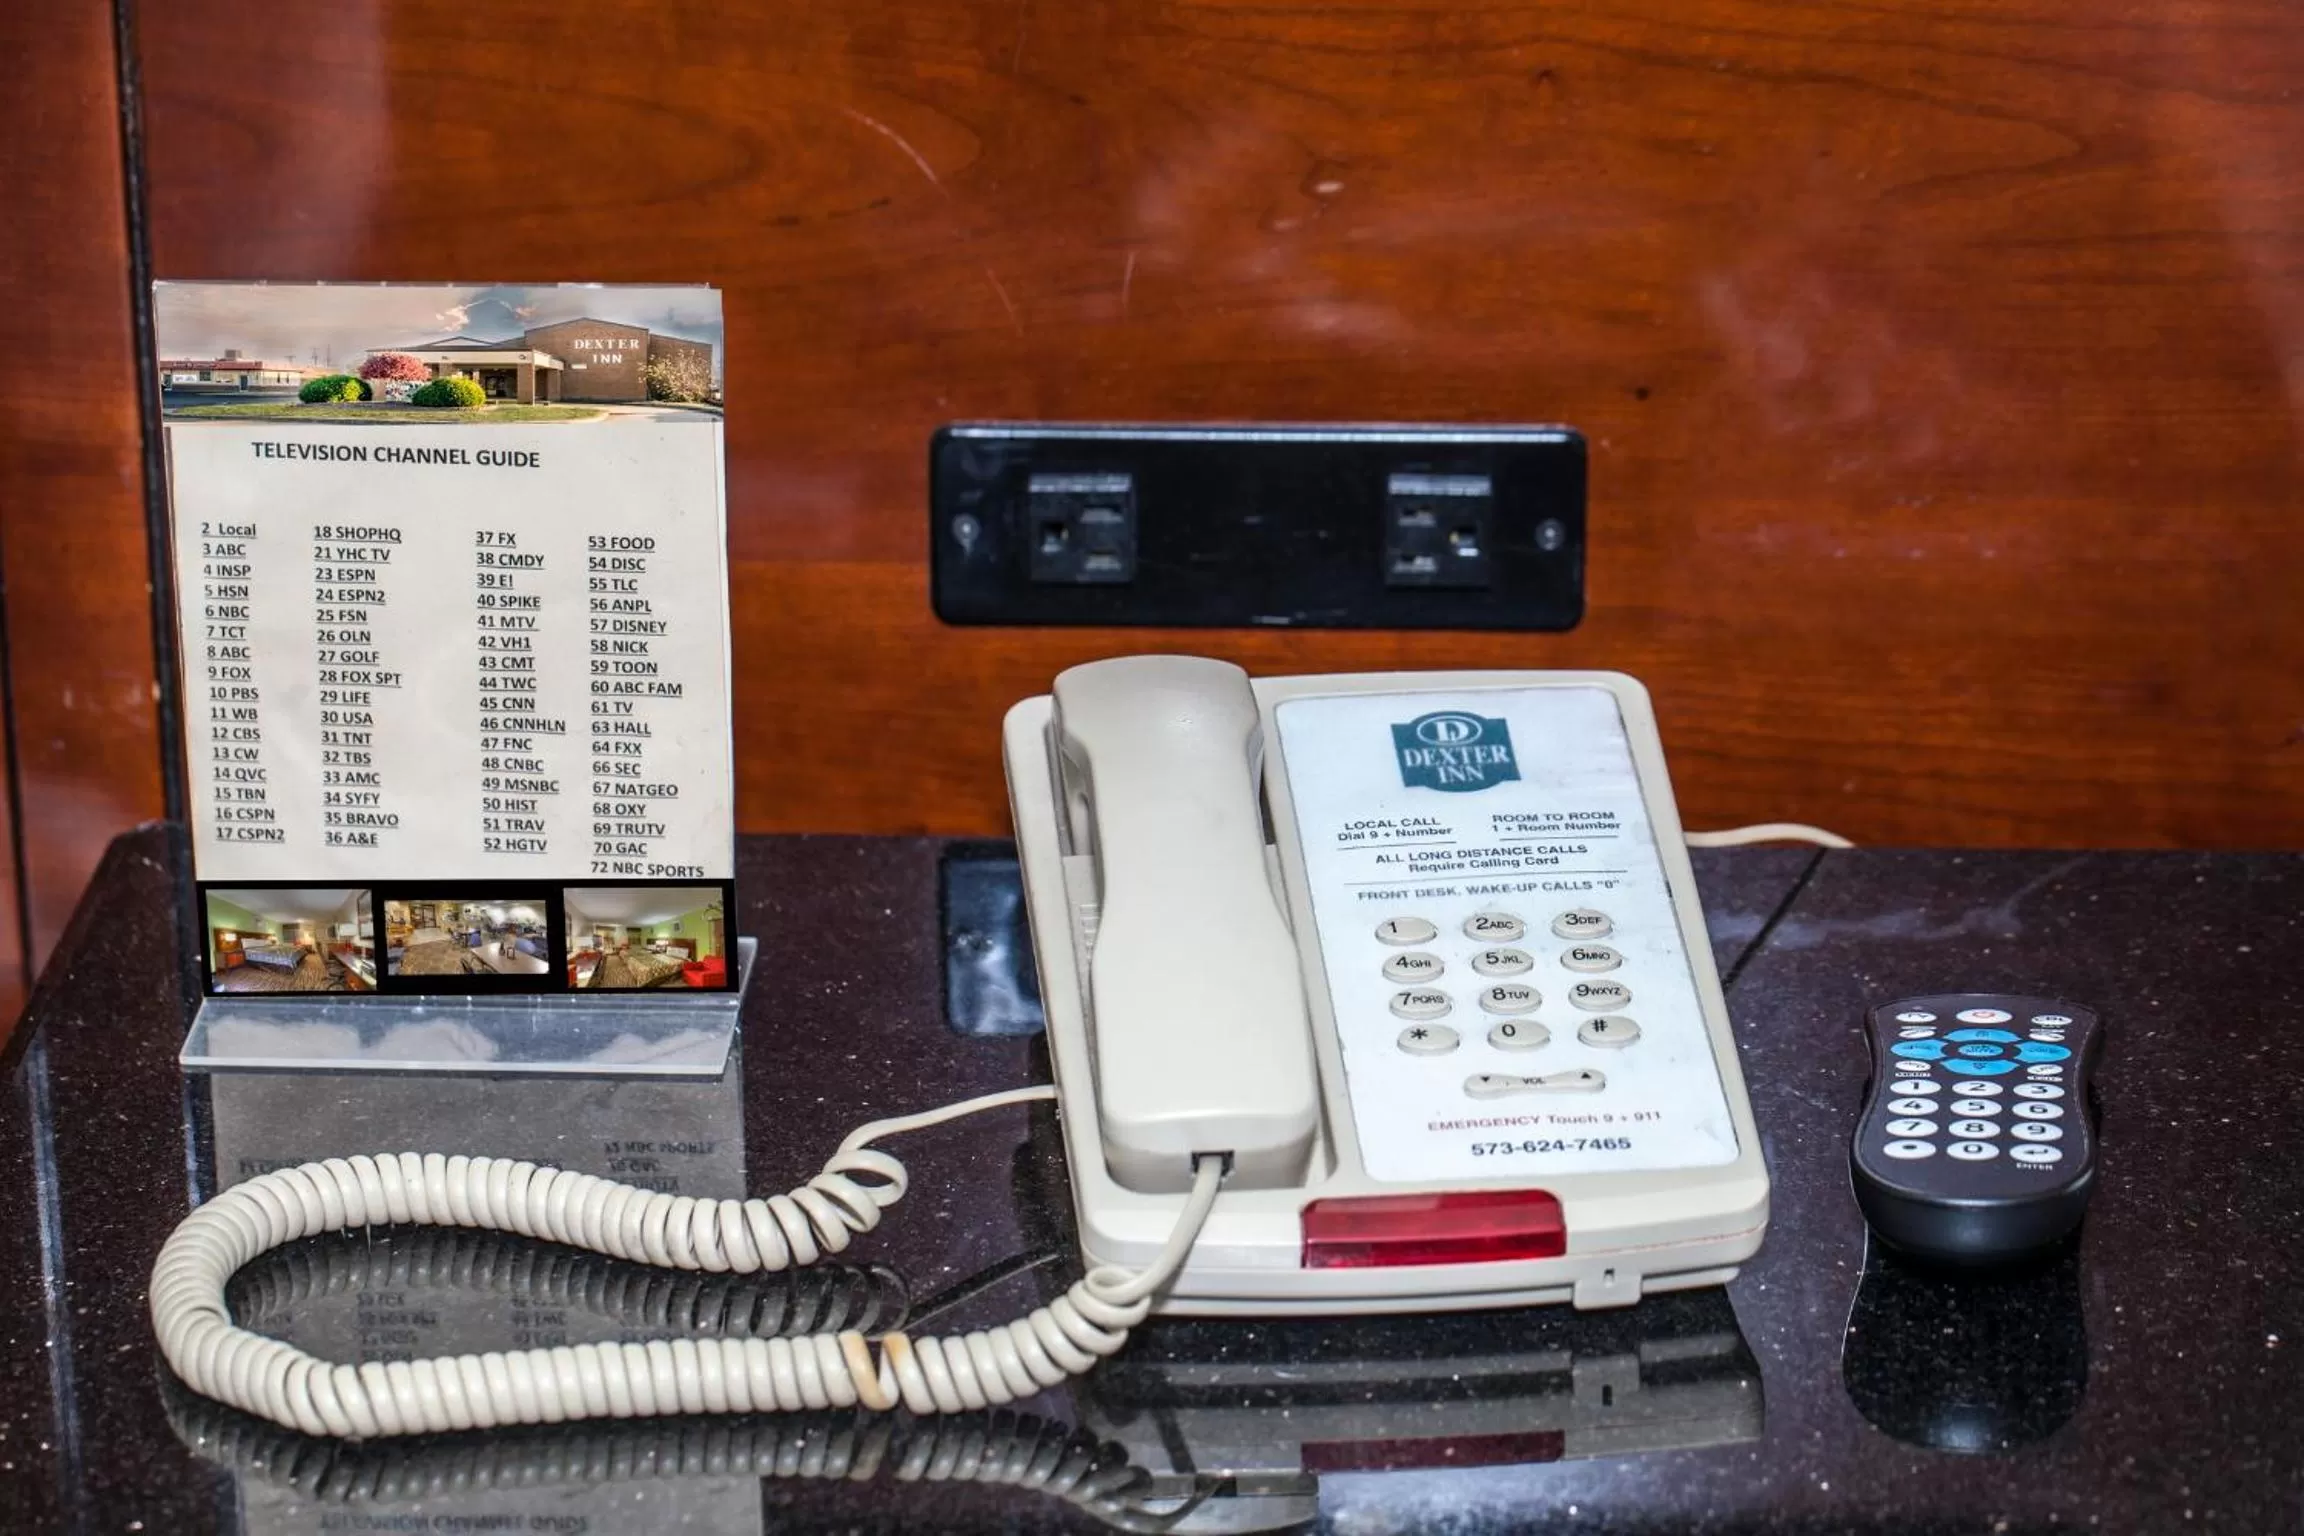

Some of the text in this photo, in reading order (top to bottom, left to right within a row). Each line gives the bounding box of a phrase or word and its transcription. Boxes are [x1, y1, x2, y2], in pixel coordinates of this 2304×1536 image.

[575, 339, 639, 349] DEXTER
[593, 354, 622, 363] INN
[252, 442, 540, 468] TELEVISION CHANNEL GUIDE
[202, 523, 257, 537] 2 Local
[315, 526, 402, 543] 18 SHOPHQ
[476, 532, 516, 546] 37 FX
[589, 536, 655, 550] 53 FOOD
[477, 553, 545, 567] 38 CMDY
[589, 557, 647, 571] 54 DISC
[204, 565, 251, 577] 4 INSP
[316, 568, 376, 582] 23 ESPN
[205, 586, 249, 598] 5 HSN
[316, 589, 386, 603] 24 ESPN2
[478, 594, 541, 609] 40 SPIKE
[590, 599, 652, 613] 56 ANPL
[206, 606, 251, 619] 6 NBC
[478, 615, 536, 628] 41 MTV
[590, 619, 668, 634] 57 DISNEY
[317, 630, 371, 643] 26 OLN
[208, 647, 251, 659] 8 ABC
[318, 651, 381, 664] 27 GOLF
[479, 656, 536, 669] 43 CMT
[591, 660, 659, 674] 59 TOON
[208, 667, 251, 679] 9 FOX
[479, 677, 537, 690] 44 TWC
[591, 681, 683, 695] 60 ABC FAM
[210, 688, 259, 700] 10 PBS
[320, 691, 371, 704] 29 LIFE
[211, 708, 258, 720] 11 WB
[321, 711, 374, 724] 30 USA
[481, 717, 566, 732] 46 CNNHLN
[592, 722, 652, 735] 63 HALL
[212, 728, 261, 740] 12 CBS
[213, 748, 259, 760] 13 CW
[323, 752, 372, 764] 32 TBS
[1404, 744, 1511, 767] DEXTER
[482, 757, 545, 772] 48 CNBC
[214, 768, 268, 781] 14 QVC
[323, 772, 382, 785] 33 AMC
[1438, 764, 1485, 784] INN
[482, 778, 560, 793] 49 MSNBC
[593, 782, 679, 797] 67 NATGEO
[216, 808, 275, 821] 16 CSPN
[593, 802, 647, 817] 68 OXY
[325, 812, 399, 826] 35 BRAVO
[1345, 816, 1440, 830] LOCAL CALL
[1493, 811, 1615, 823] ROOM TO ROOM
[484, 818, 545, 832] 51 TRAV
[594, 822, 666, 836] 69 TRUTV
[1518, 822, 1560, 832] Room
[1565, 821, 1621, 831] Number
[217, 828, 285, 841] 17 CSPN2
[325, 832, 379, 845] 36 A&E
[1338, 826, 1452, 841] Dial 9 Number
[484, 838, 548, 851] 52 HGTV
[1376, 844, 1588, 864] ALL LONG DISTANCE CALLS
[591, 862, 705, 878] 72 NBC SPORTS
[1409, 855, 1559, 874] Require Calling Card
[1358, 889, 1409, 901] FRONT
[1467, 882, 1537, 896] WAKE-UP
[1542, 880, 1592, 891] CALLS
[1388, 922, 1397, 933] 1
[1502, 1024, 1516, 1037] 0
[1970, 1083, 1986, 1091] 2
[1904, 1100, 1921, 1110] 4
[1968, 1102, 1985, 1111] 5
[2030, 1104, 2047, 1115] 6
[1428, 1111, 1661, 1131] EMERGENCY Touch 9 911
[1965, 1123, 1984, 1133] 8
[2028, 1125, 2046, 1135] 9
[1472, 1137, 1631, 1156] 573-624-7465
[1963, 1144, 1983, 1154] 0
